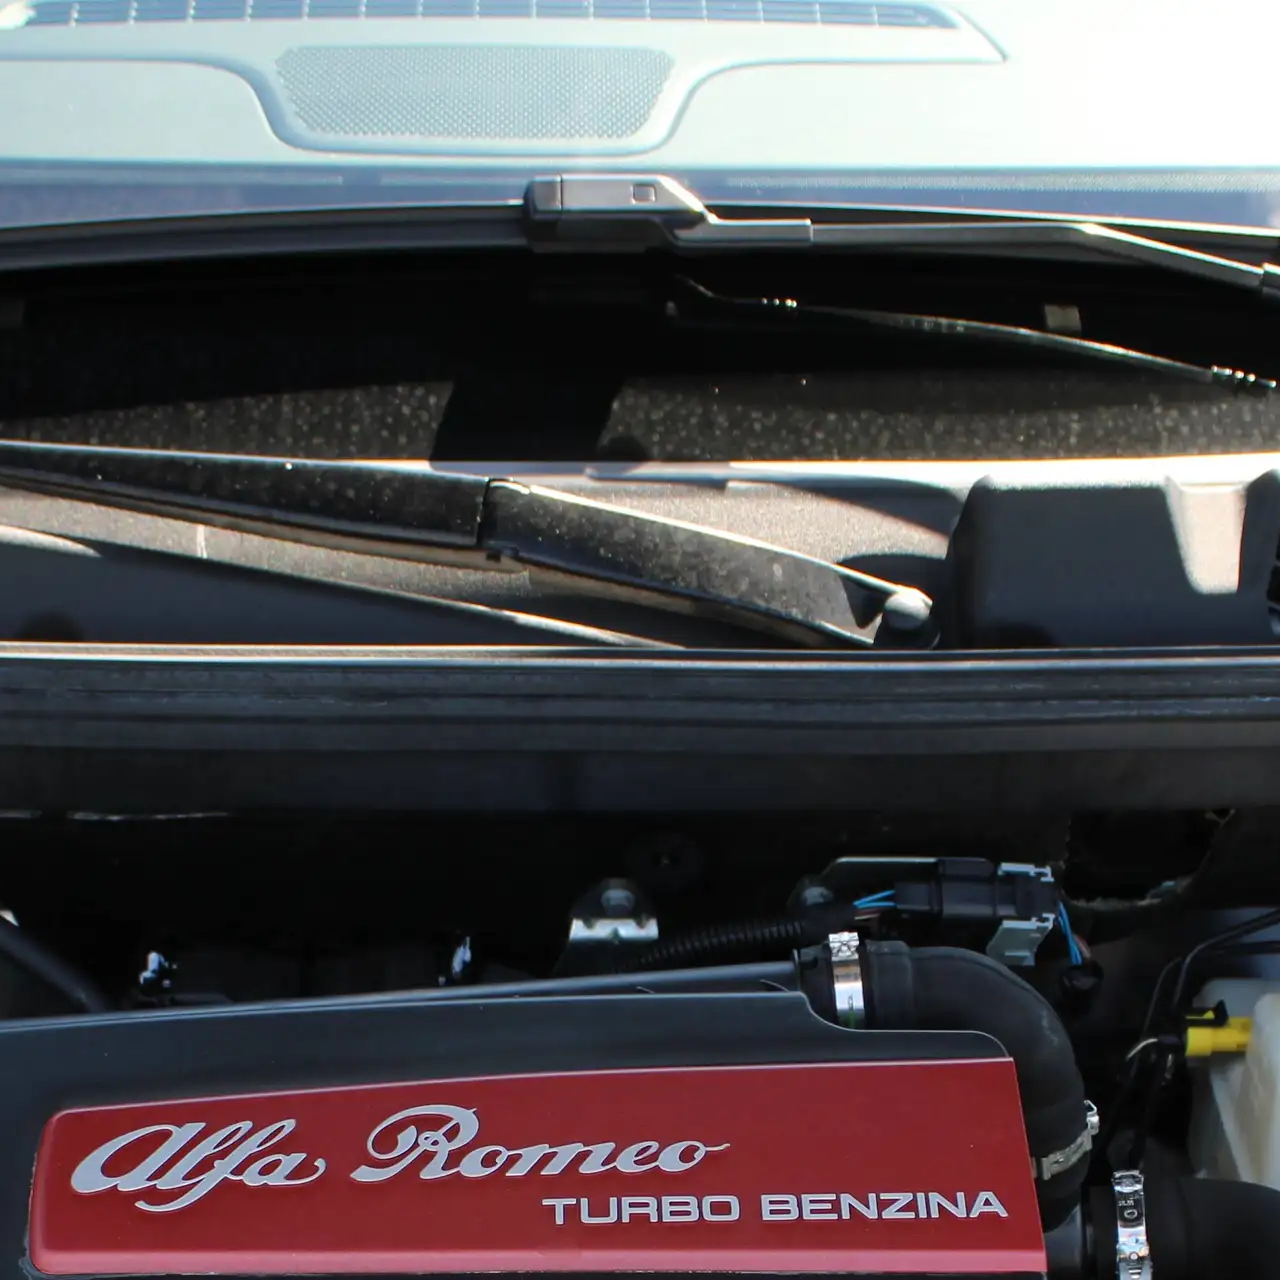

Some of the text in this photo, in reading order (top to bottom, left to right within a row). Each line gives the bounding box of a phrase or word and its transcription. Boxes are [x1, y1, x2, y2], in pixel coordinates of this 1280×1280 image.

[71, 1104, 730, 1211] Alfa Romeo
[541, 1191, 1009, 1224] TURBO BENZINA
